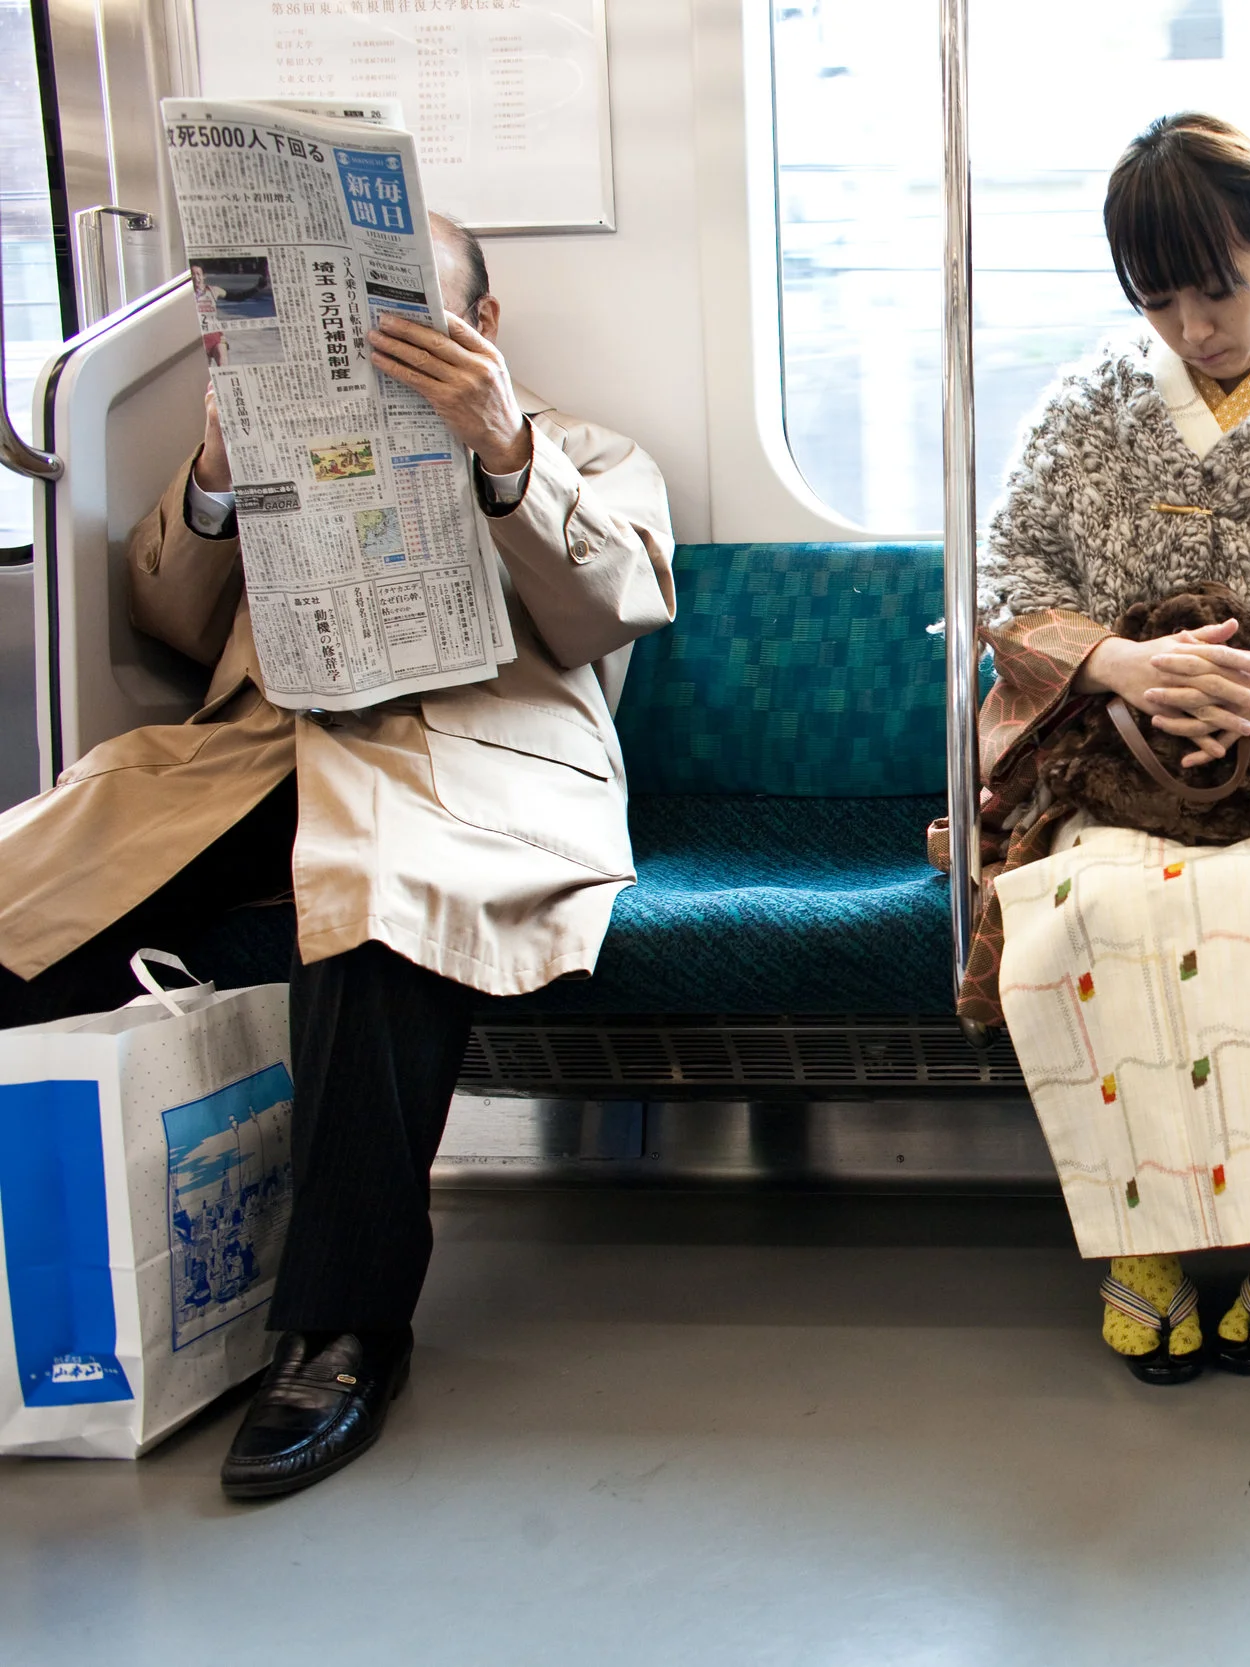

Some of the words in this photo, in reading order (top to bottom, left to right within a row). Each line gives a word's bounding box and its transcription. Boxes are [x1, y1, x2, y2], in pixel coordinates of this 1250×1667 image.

[343, 255, 366, 361] 3人乗り自転車購入
[265, 499, 299, 510] GAORA
[314, 609, 341, 682] 動機の修辞学
